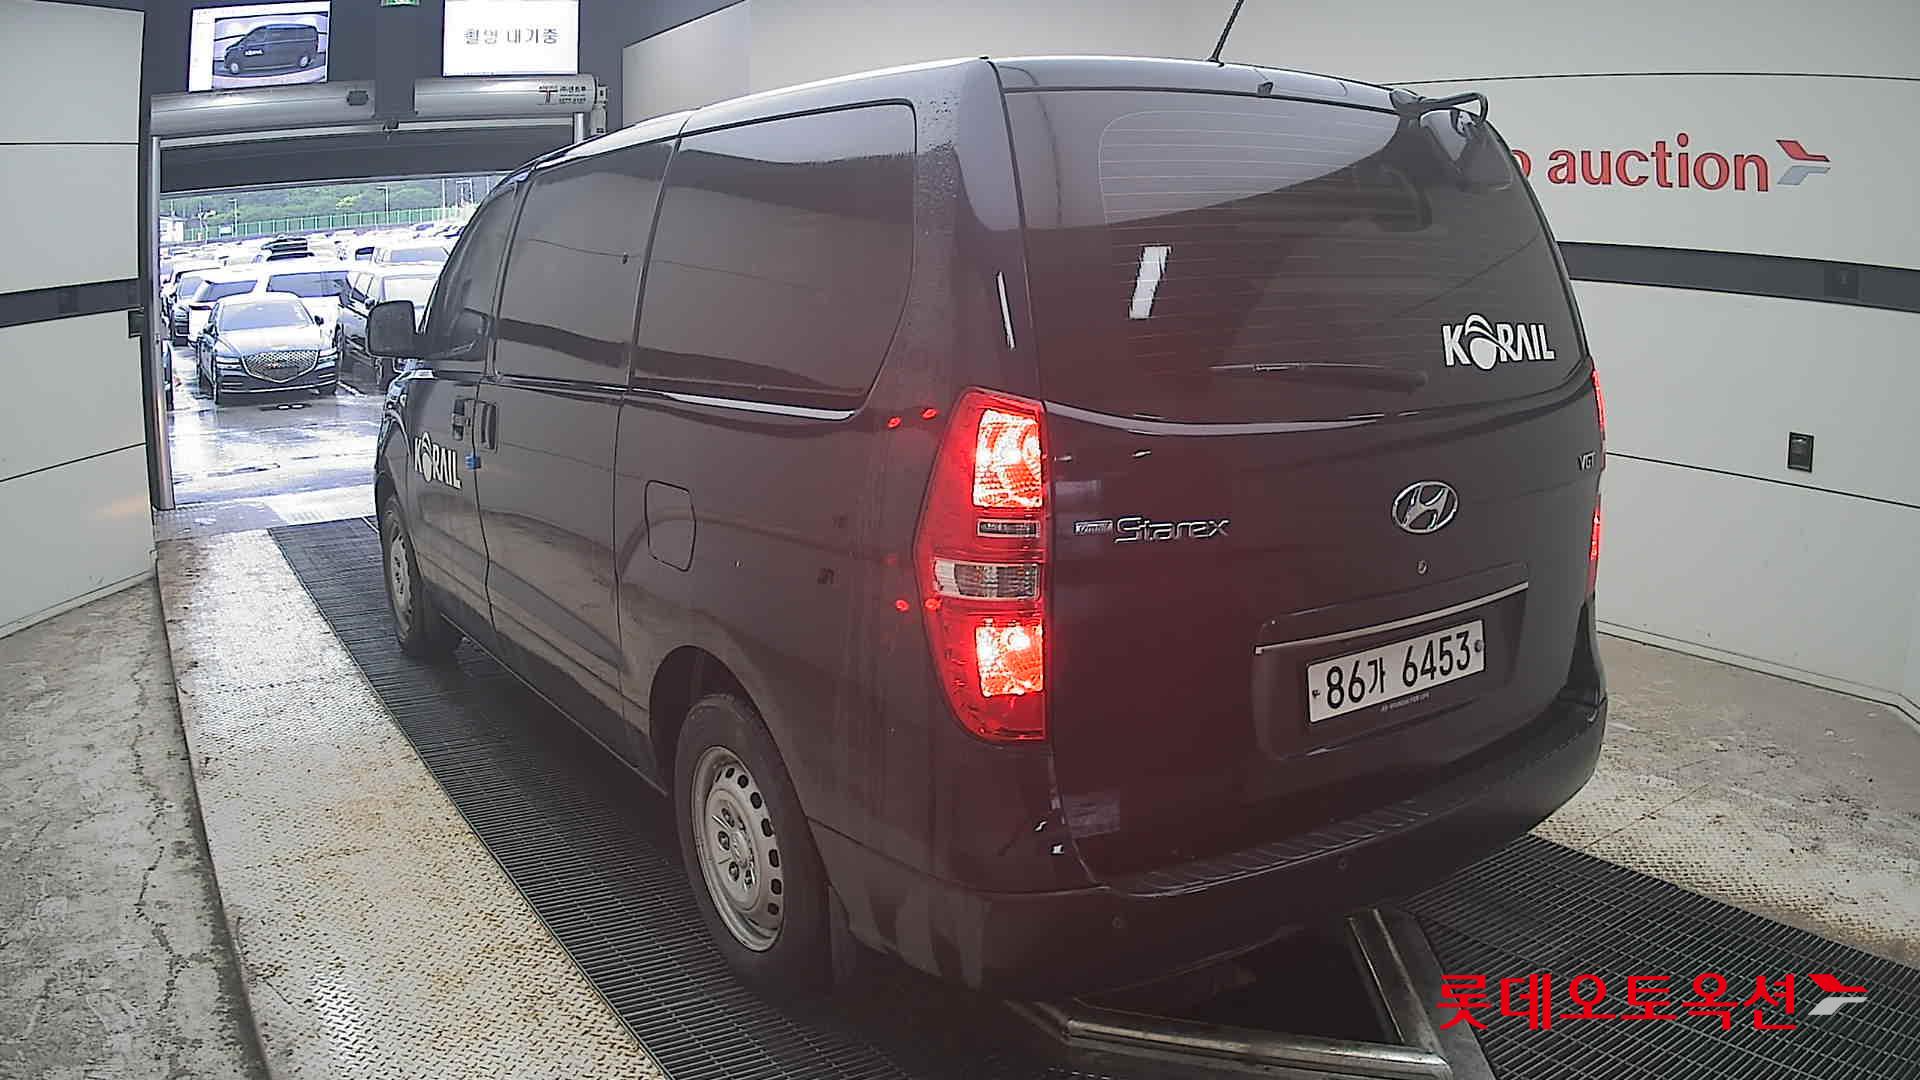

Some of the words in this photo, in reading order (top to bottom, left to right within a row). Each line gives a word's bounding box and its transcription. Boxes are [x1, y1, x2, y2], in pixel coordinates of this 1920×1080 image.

[1547, 133, 1769, 192] auction
[1442, 313, 1555, 370] KORAIL
[414, 431, 462, 489] KORAIL
[1115, 517, 1229, 543] Starex
[1327, 657, 1386, 709] 86가
[1402, 630, 1470, 687] 6453
